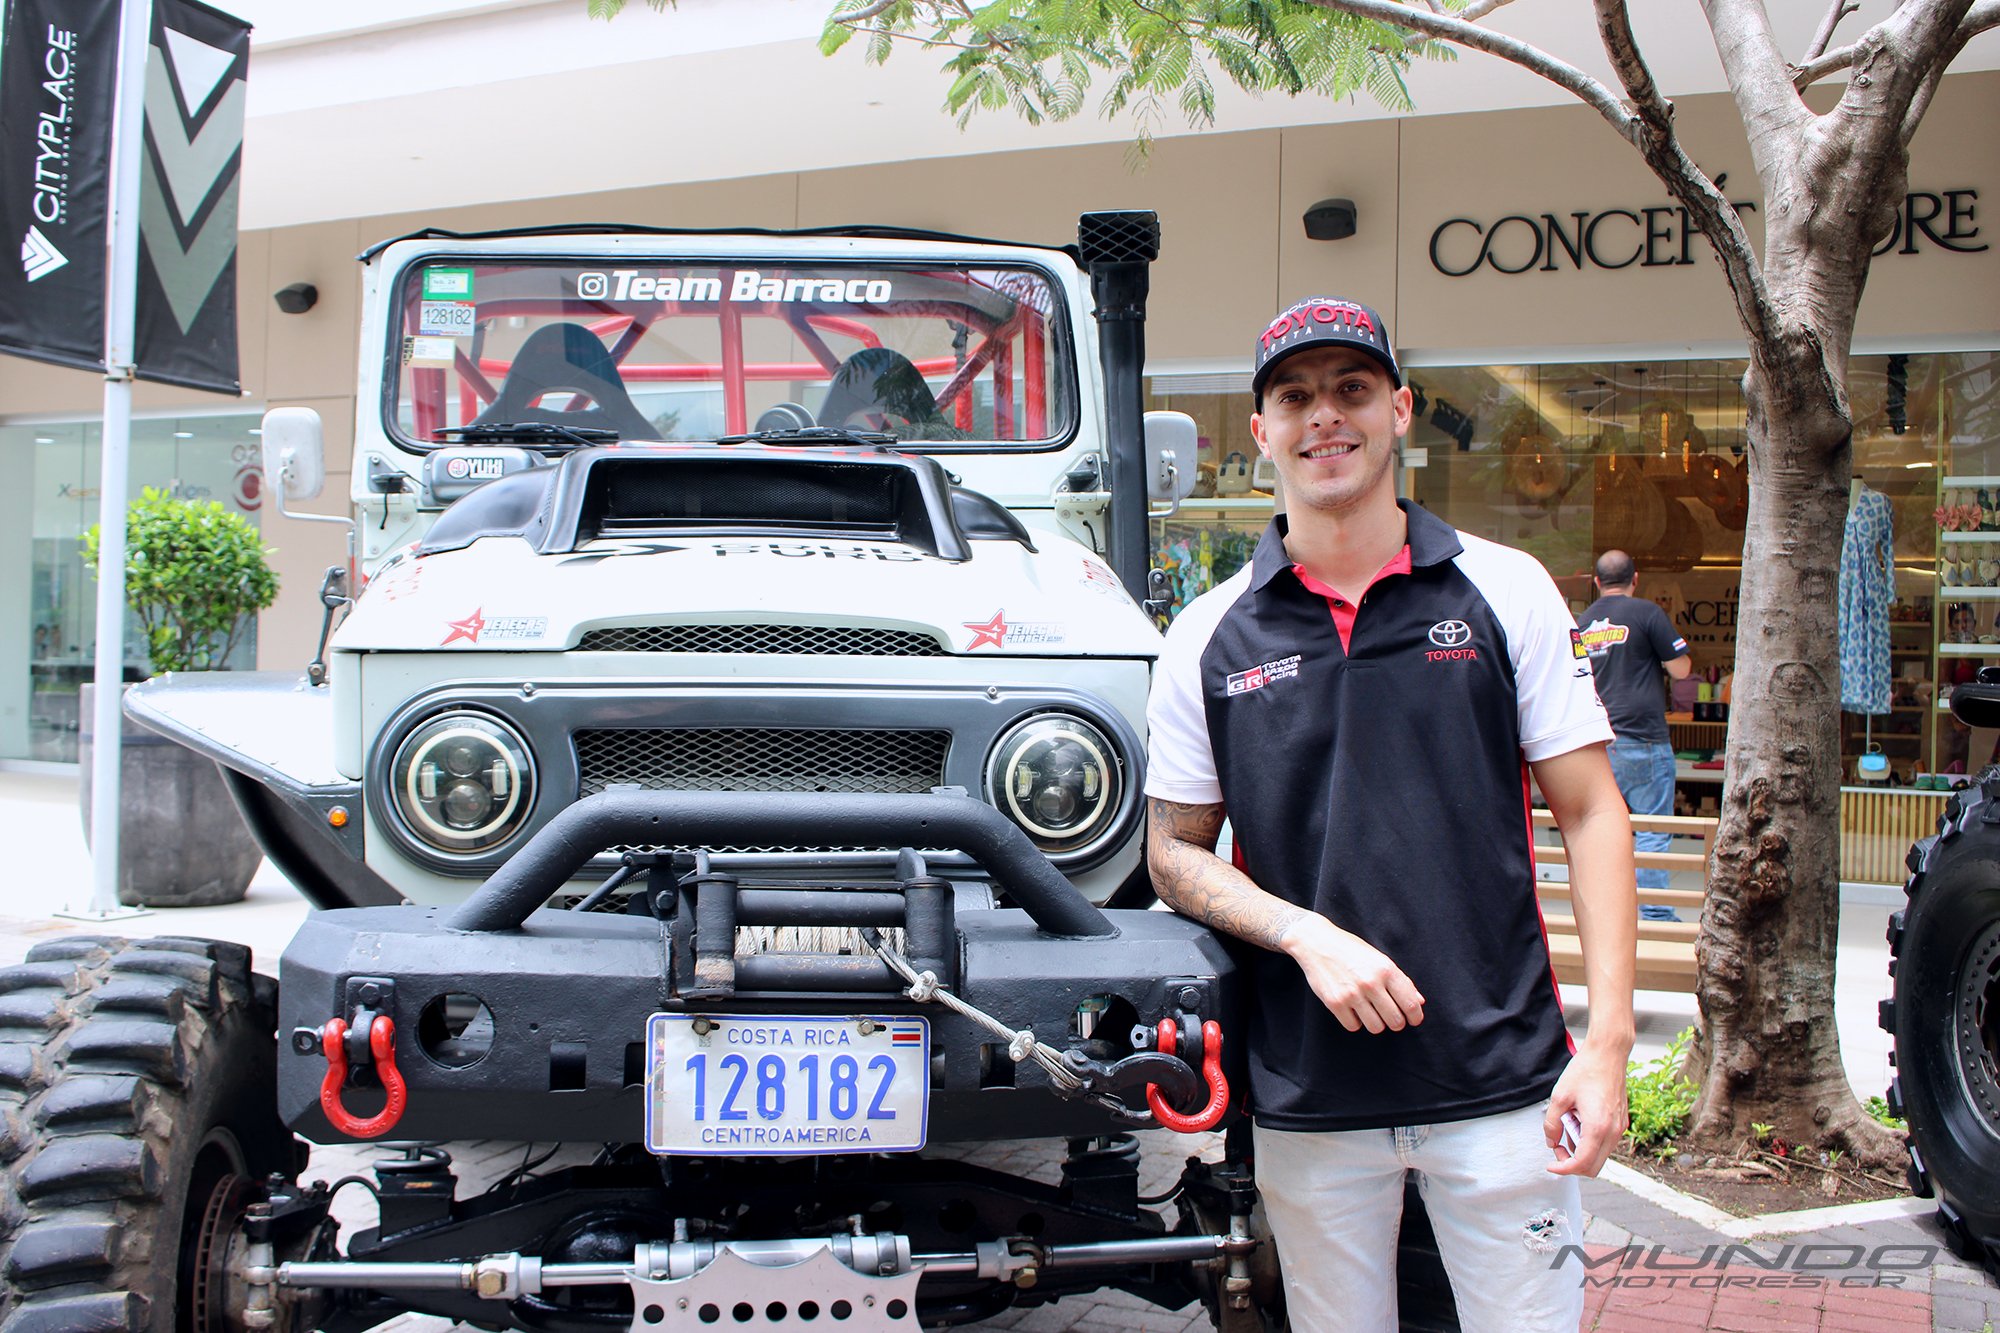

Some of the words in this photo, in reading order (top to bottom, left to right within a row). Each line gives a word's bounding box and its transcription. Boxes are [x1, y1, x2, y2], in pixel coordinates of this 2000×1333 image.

[33, 24, 70, 222] CITYPLACE
[613, 270, 722, 302] Team
[729, 270, 892, 304] Barraco
[425, 308, 471, 325] 128182
[1261, 305, 1375, 351] TOYOTA
[1263, 326, 1312, 362] COSTA
[1333, 324, 1375, 344] RICA
[1262, 654, 1302, 670] TOYOTA
[1425, 649, 1477, 662] TOYOTA
[1263, 662, 1298, 677] GAZOO
[1264, 669, 1298, 685] Racing
[1229, 674, 1262, 693] GR
[727, 1028, 793, 1045] COSTA
[805, 1028, 850, 1046] RICA
[685, 1054, 897, 1121] 128182
[701, 1127, 872, 1144] CENTROAMERICA
